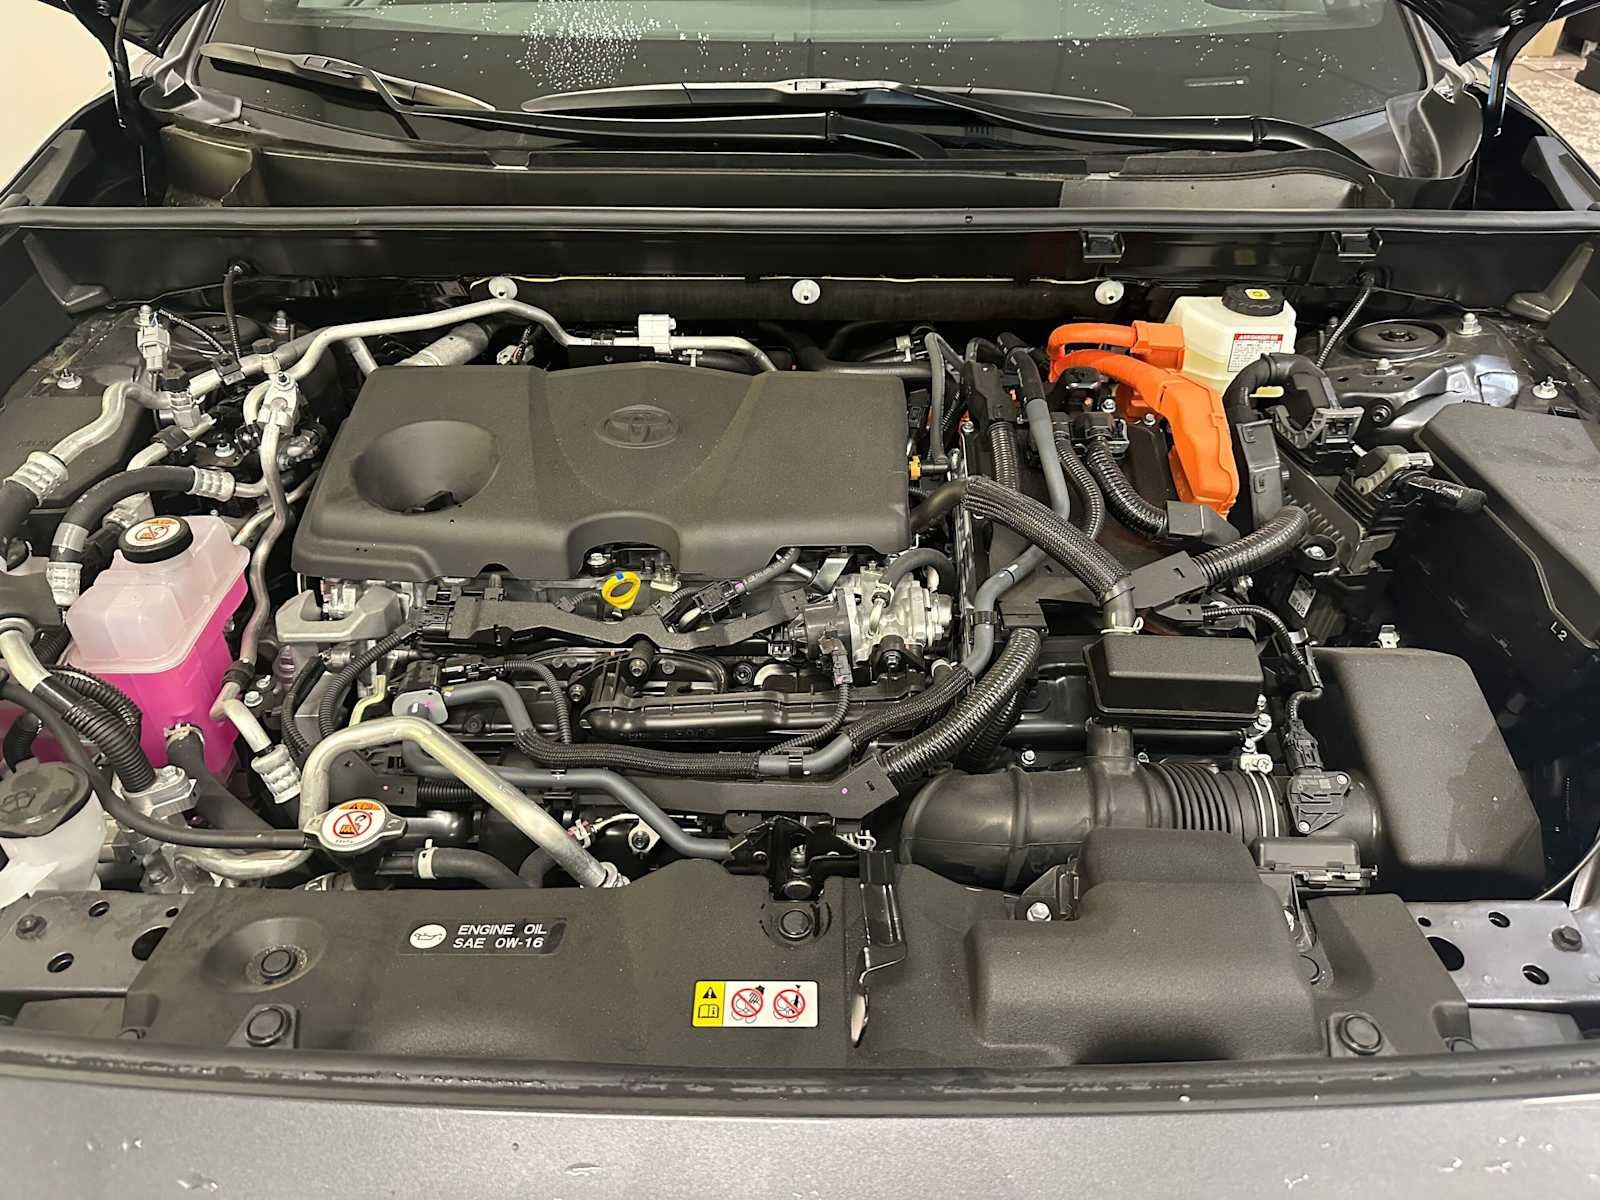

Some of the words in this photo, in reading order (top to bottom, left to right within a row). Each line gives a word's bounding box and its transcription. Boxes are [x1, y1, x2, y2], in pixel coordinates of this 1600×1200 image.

[1550, 621, 1568, 642] L2
[457, 924, 515, 936] ENGINE
[523, 923, 548, 935] OIL
[452, 937, 486, 949] SAE
[494, 937, 545, 949] 0W-16
